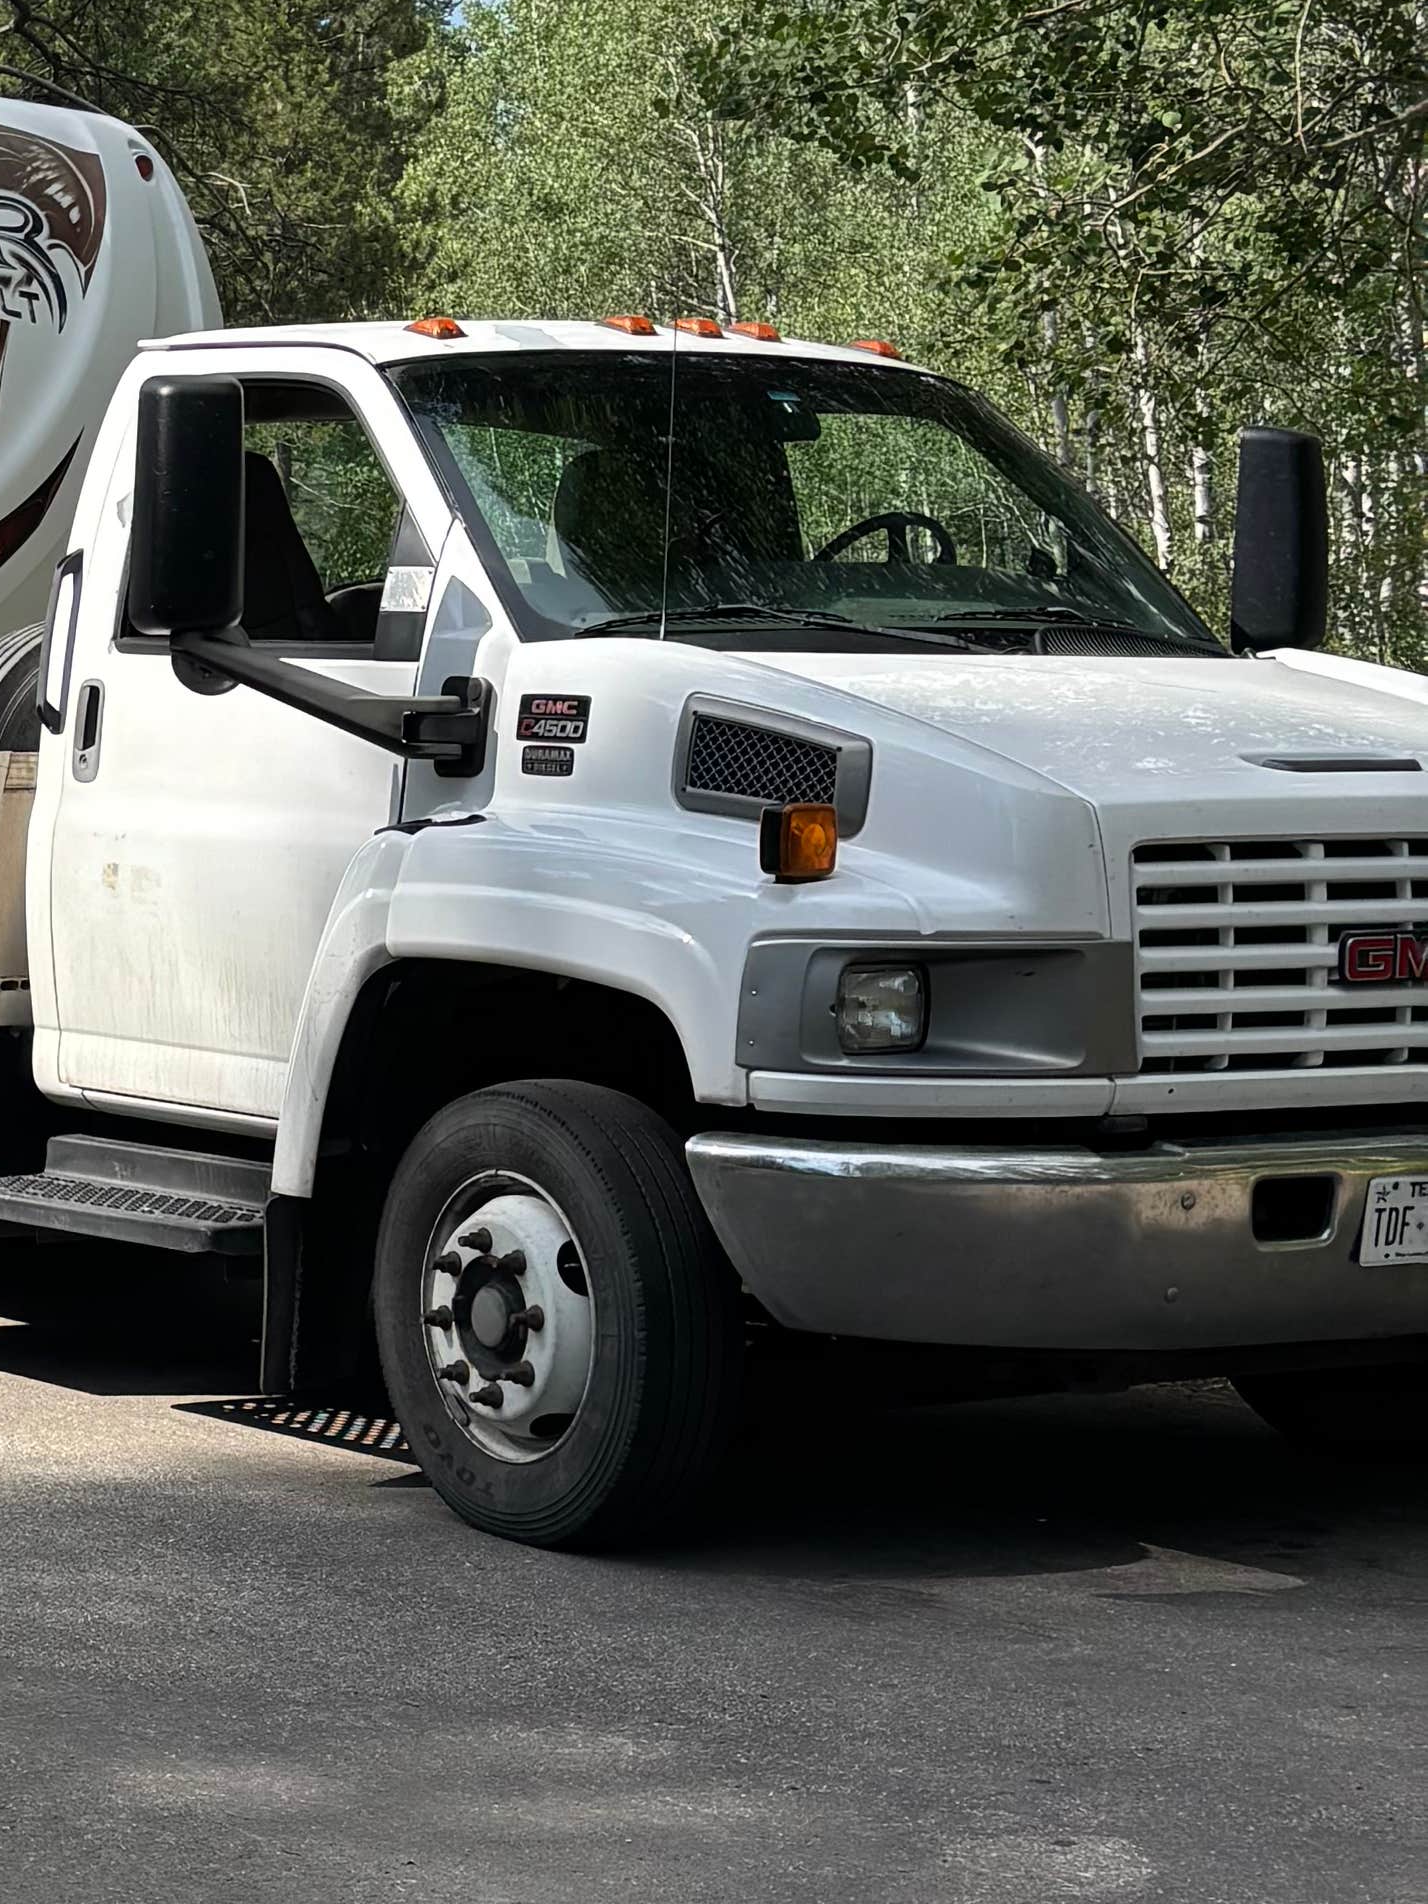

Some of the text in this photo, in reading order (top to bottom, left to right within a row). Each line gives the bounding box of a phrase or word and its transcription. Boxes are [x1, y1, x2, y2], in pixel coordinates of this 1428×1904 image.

[531, 699, 578, 715] GMC
[520, 718, 584, 738] C4500
[1375, 1206, 1415, 1248] TDF
